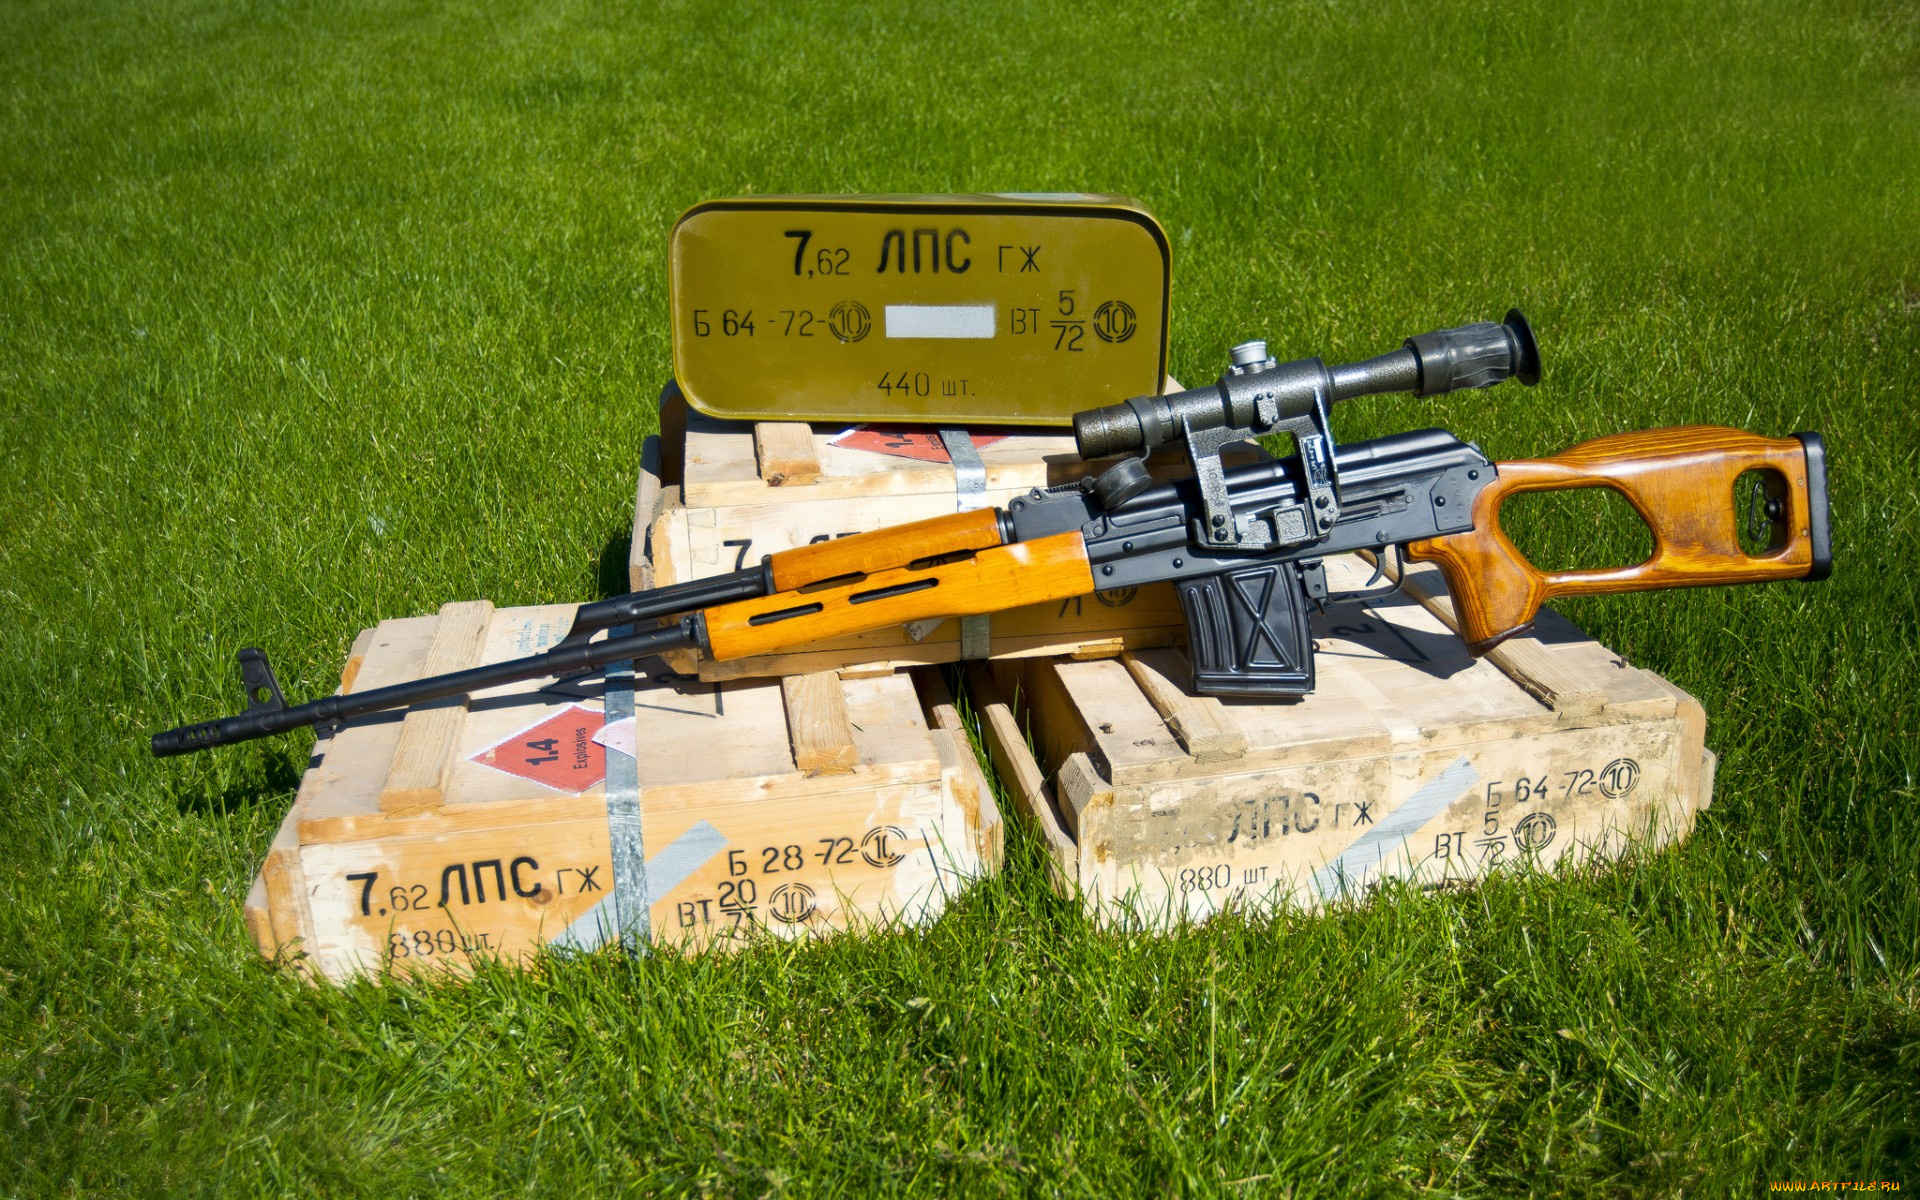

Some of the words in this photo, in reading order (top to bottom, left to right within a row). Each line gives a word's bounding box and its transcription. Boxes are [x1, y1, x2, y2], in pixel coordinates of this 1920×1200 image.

[784, 229, 850, 279] 7,62
[876, 228, 971, 274] ЛПС
[1058, 289, 1075, 316] 5
[723, 308, 755, 337] 64
[1010, 308, 1040, 335] ВТ
[1052, 325, 1085, 351] 72
[877, 372, 930, 397] 440
[525, 737, 559, 766] 1.4
[573, 727, 587, 770] Explosives
[1515, 775, 1548, 803] 64
[1435, 831, 1467, 859] ВТ
[1484, 810, 1499, 836] 5
[762, 845, 803, 873] 28
[346, 871, 430, 917] 7,62
[437, 856, 542, 908] ЛПС
[1180, 864, 1231, 893] 880
[678, 899, 713, 928] ВТ
[718, 879, 757, 908] 20
[389, 929, 455, 958] 880
